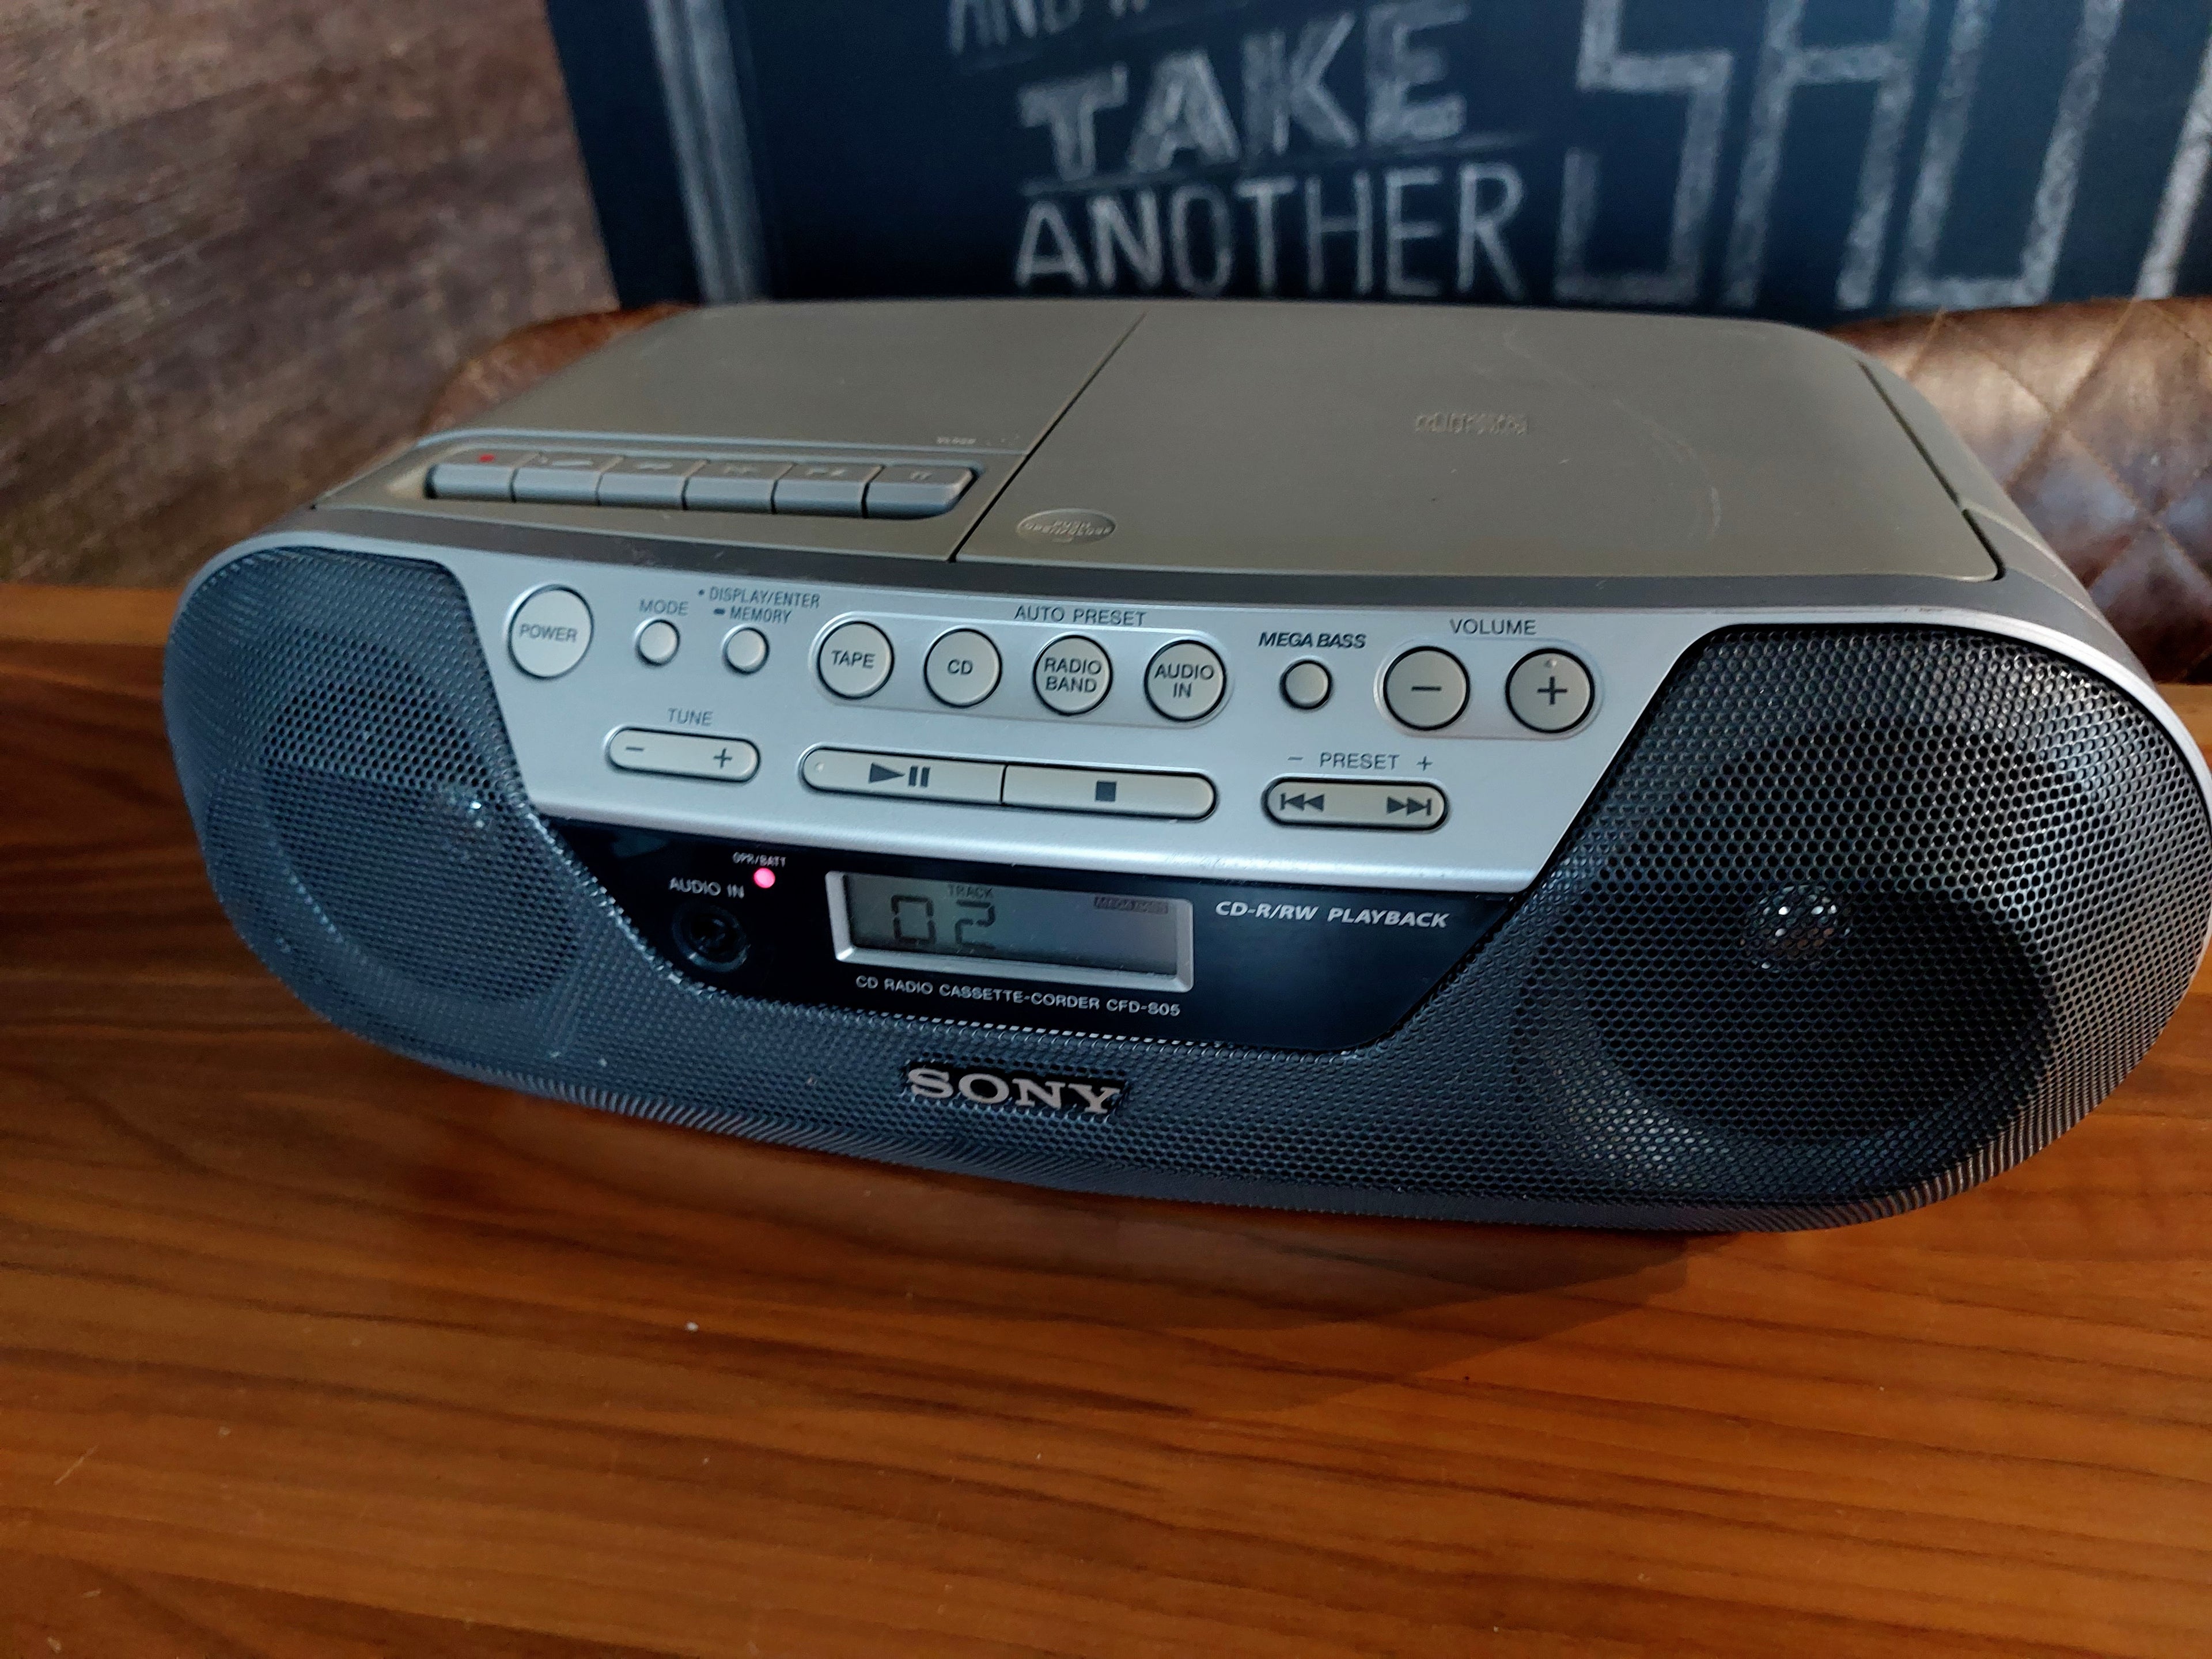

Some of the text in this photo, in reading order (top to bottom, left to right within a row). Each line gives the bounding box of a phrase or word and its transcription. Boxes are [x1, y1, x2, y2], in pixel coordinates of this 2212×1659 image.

[1018, 3, 1468, 180] TAKE
[1015, 162, 1525, 300] ANOTHER
[709, 586, 820, 609] DISPLAY/ENTER
[640, 599, 688, 616] MODE
[730, 608, 791, 624] MEMORY
[1014, 605, 1148, 626] AUTO PRESET
[520, 623, 577, 643] POWER
[1449, 618, 1537, 634] VOLUME
[1257, 631, 1366, 650] MEGA BASS
[831, 650, 876, 669] TAPE
[947, 659, 973, 675] CD
[1043, 656, 1101, 674] RADIO
[1154, 662, 1214, 680] AUDIO
[1045, 676, 1097, 693] BAND
[1173, 682, 1192, 698] IN
[668, 707, 714, 726] TUNE
[1319, 752, 1400, 770] PRESET
[669, 877, 745, 899] AUDIO IN
[1215, 900, 1450, 929] CD-R/RW PLAYBACK
[855, 975, 878, 989] CD
[884, 979, 934, 995] RADIO
[938, 983, 1100, 1011] CASSETTE-CORDER
[907, 1067, 1120, 1115] SONY
